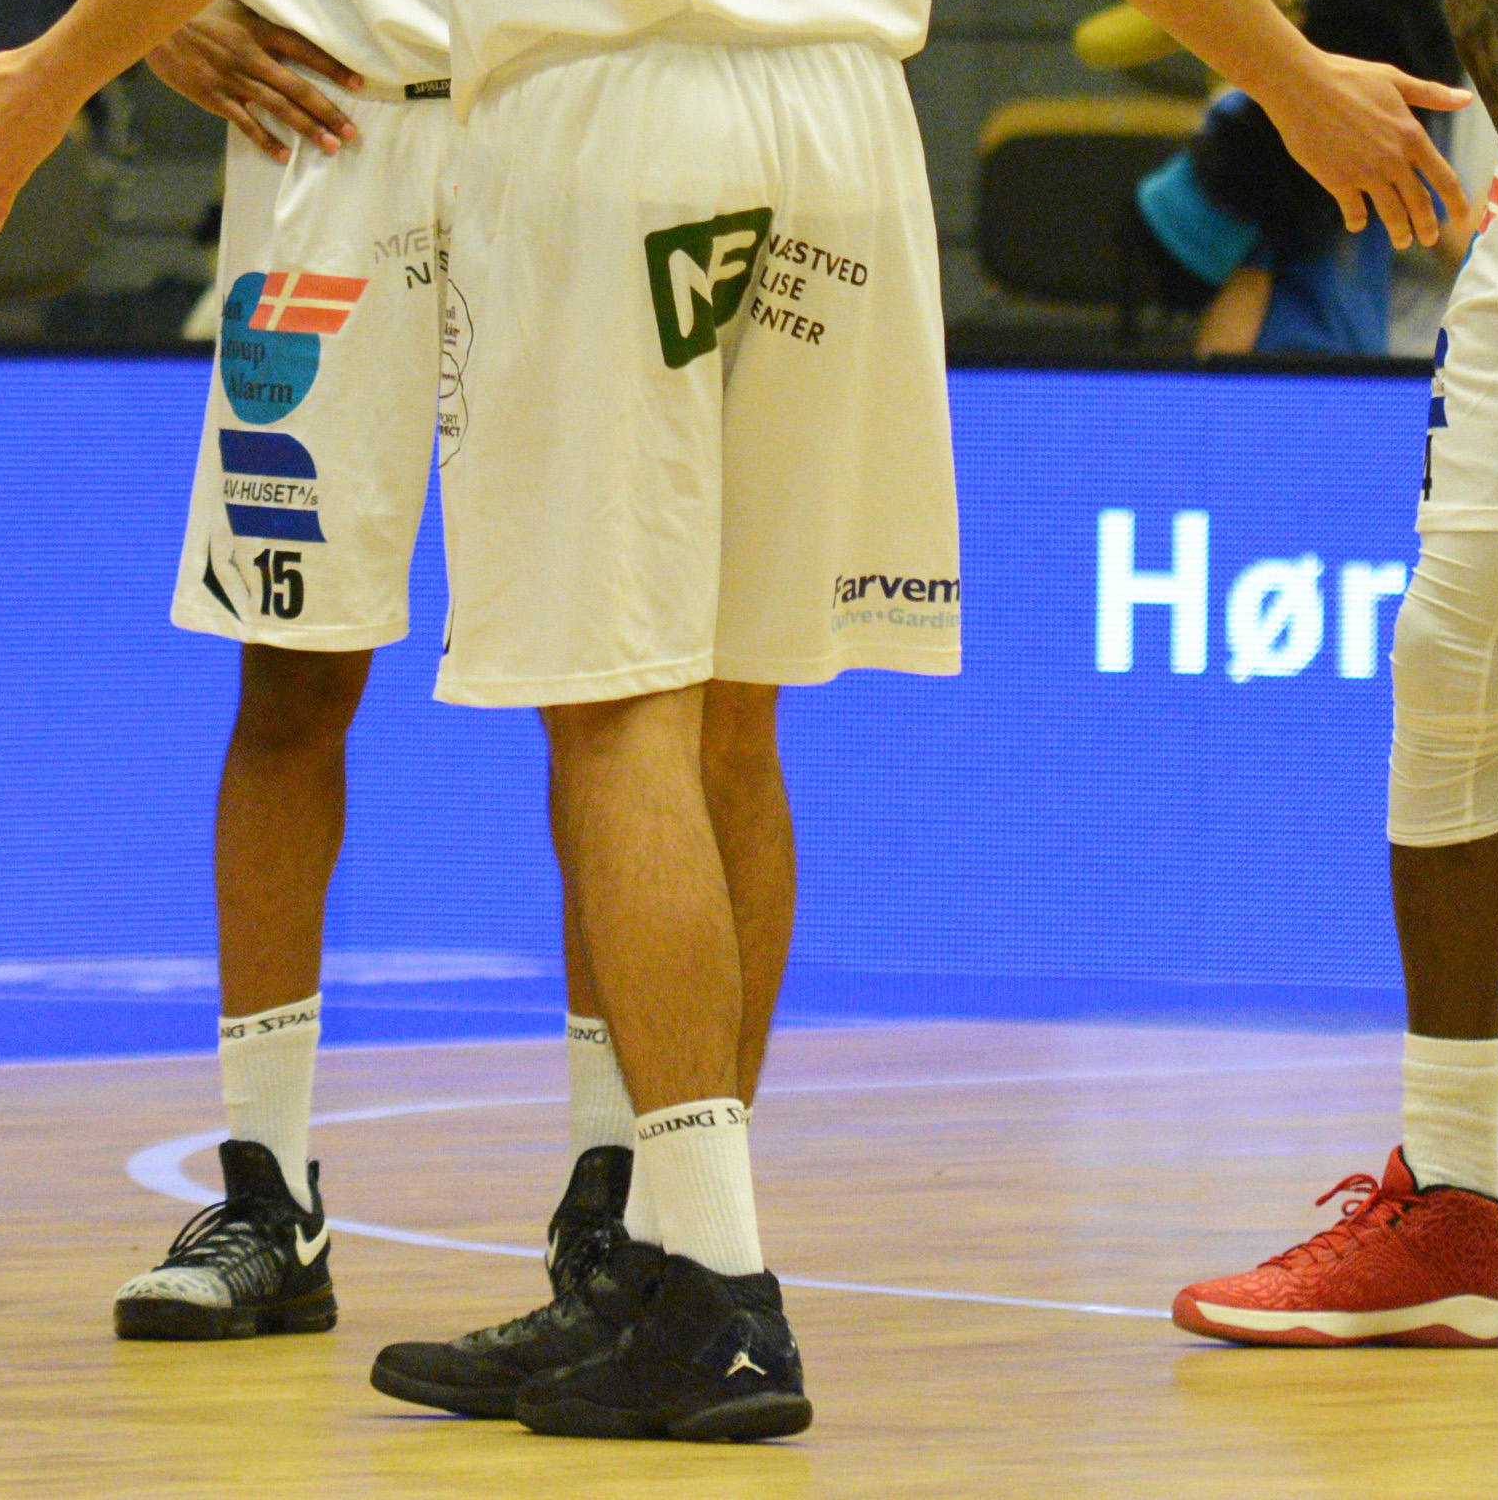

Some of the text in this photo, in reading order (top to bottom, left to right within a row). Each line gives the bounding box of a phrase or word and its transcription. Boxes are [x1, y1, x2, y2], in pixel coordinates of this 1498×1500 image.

[759, 265, 806, 301] LISE
[750, 297, 825, 346] ENTER
[253, 548, 305, 620] 15
[1095, 508, 1409, 683] Hør
